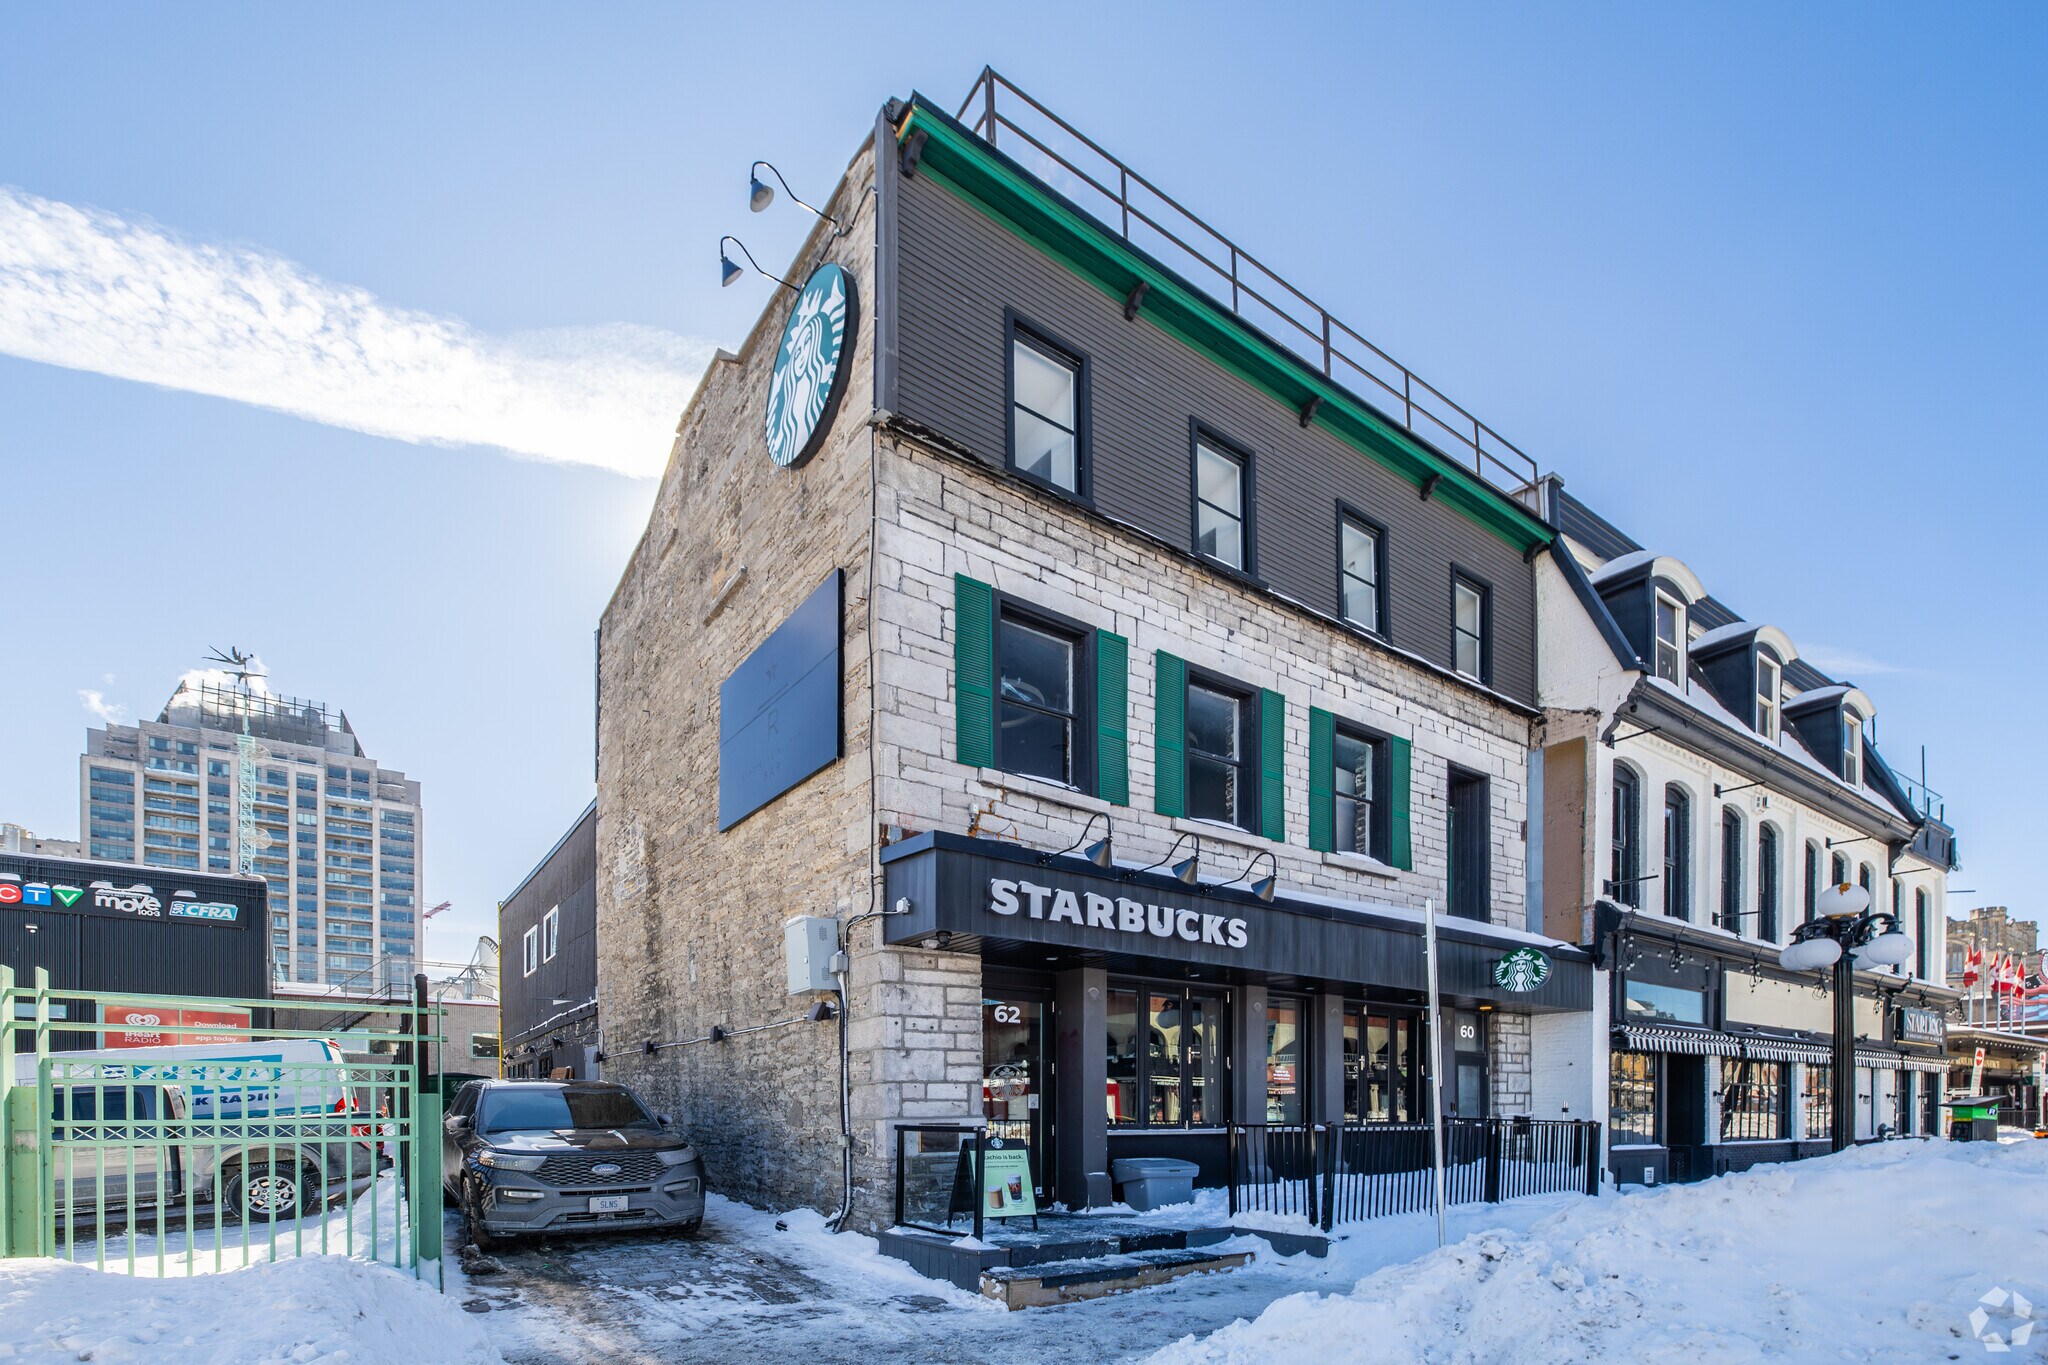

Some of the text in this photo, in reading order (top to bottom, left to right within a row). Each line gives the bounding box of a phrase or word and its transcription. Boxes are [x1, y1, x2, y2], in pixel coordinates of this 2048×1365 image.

[95, 895, 162, 912] move
[185, 904, 233, 919] CFRA
[990, 878, 1248, 948] STARBUCKS
[995, 1005, 1021, 1024] 62
[195, 1034, 238, 1043] app today
[1460, 1025, 1475, 1039] 60
[124, 1036, 161, 1044] RADIO
[600, 1200, 618, 1209] SLNS
